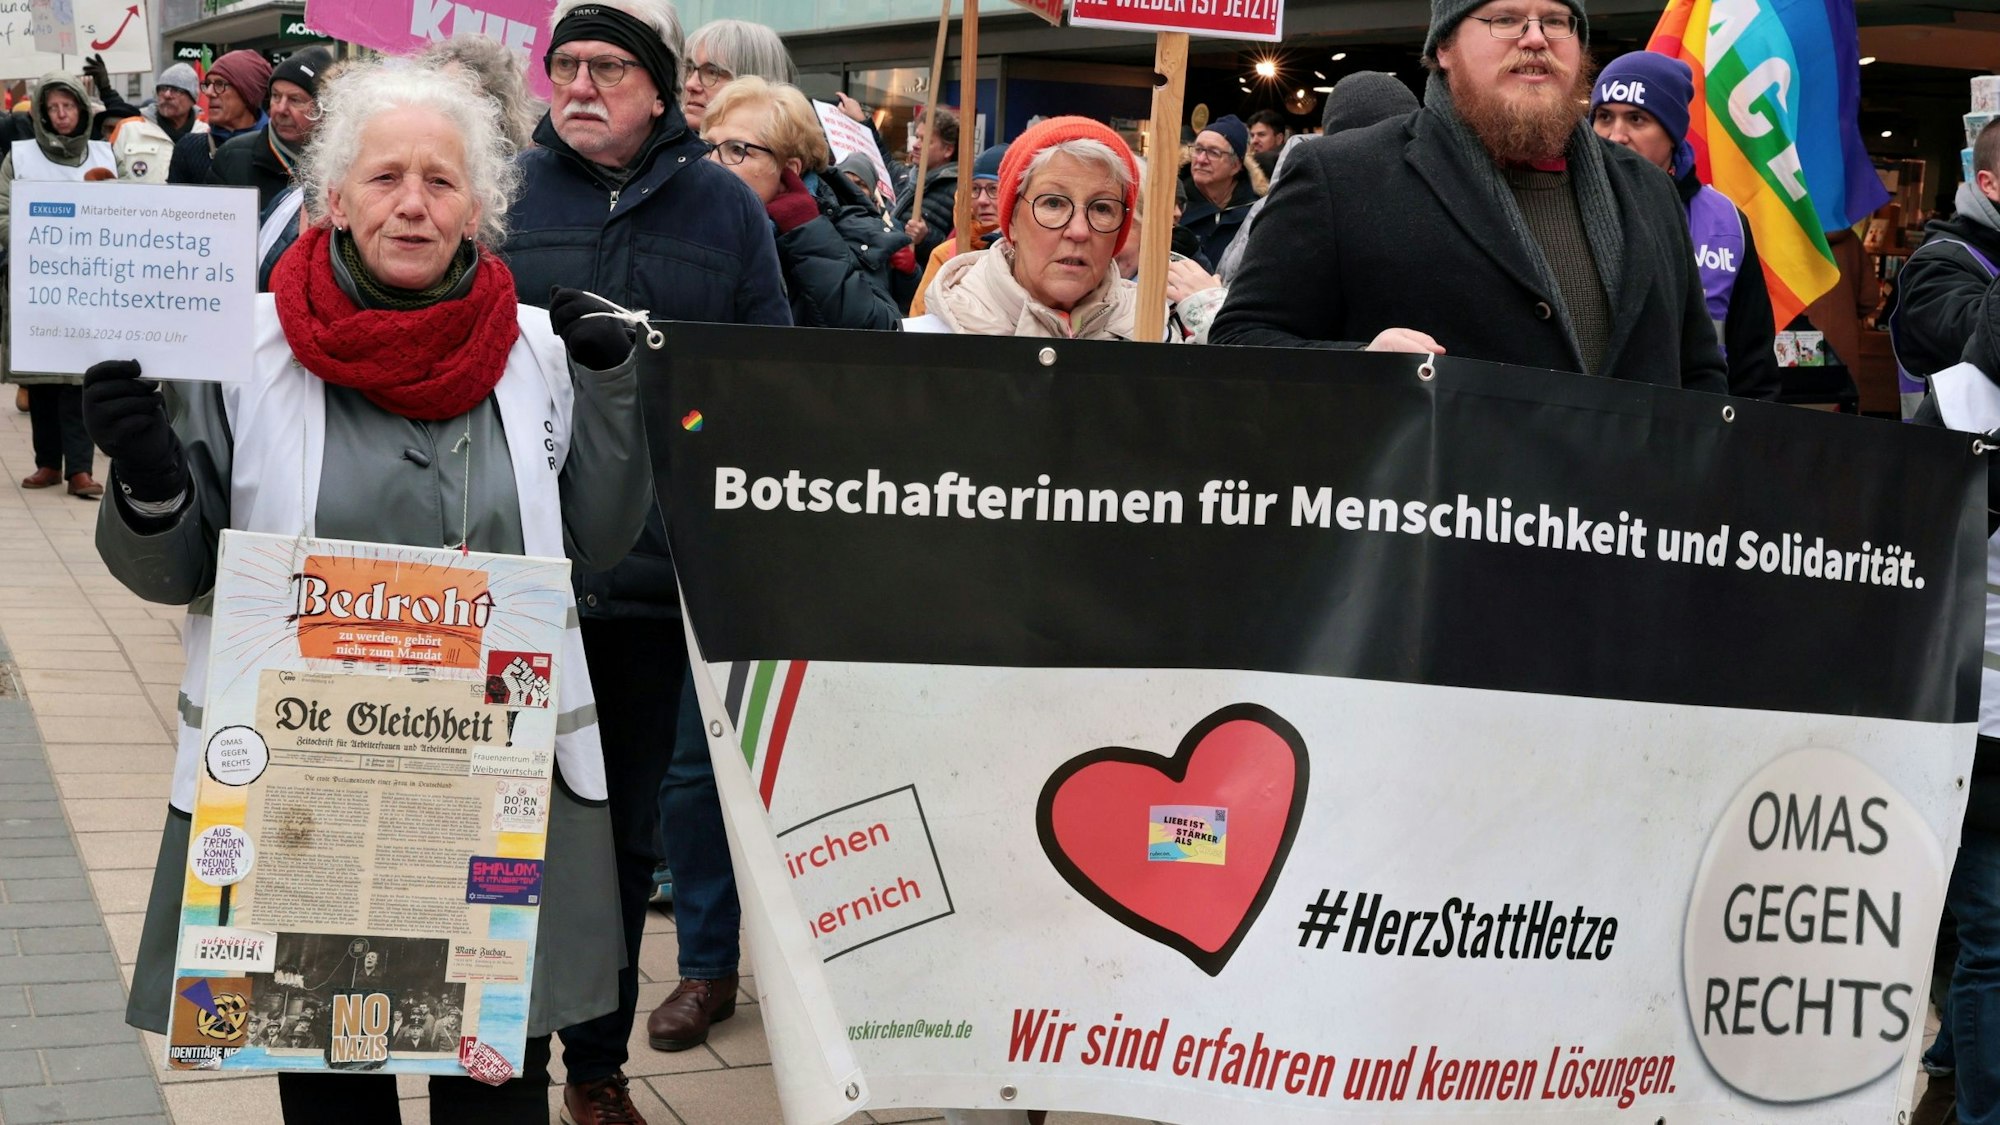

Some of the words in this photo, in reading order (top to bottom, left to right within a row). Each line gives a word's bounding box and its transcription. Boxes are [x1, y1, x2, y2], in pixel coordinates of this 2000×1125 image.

[1601, 80, 1646, 105] Volt
[33, 206, 71, 214] EXKLUSIV
[80, 205, 138, 217] Mitarbeiter
[140, 208, 158, 217] von
[161, 208, 236, 222] Abgeordneten
[28, 225, 63, 245] AfD
[69, 226, 92, 246] im
[100, 228, 212, 257] Bundestag
[1694, 244, 1736, 272] Volt
[29, 254, 135, 283] beschäftigt
[142, 260, 199, 281] mehr
[205, 262, 234, 282] als
[28, 286, 61, 305] 100
[67, 287, 221, 312] Rechtsextreme
[29, 326, 62, 337] Stand:
[63, 328, 122, 340] 12.03.2024
[125, 330, 161, 342] 05:00
[164, 332, 188, 343] Uhr
[715, 467, 1183, 524] Botschafterinnen
[1199, 479, 1278, 526] für
[1290, 485, 1647, 558] Menschlichkeit
[1657, 524, 1730, 567] und
[1735, 530, 1925, 590] Solidarität.
[339, 631, 353, 641] zu
[356, 631, 401, 645] werden,
[404, 634, 443, 647] gehört
[337, 645, 366, 656] nicht
[368, 649, 394, 658] zum
[397, 648, 443, 661] Mandat
[275, 697, 332, 732] Die
[347, 702, 493, 743] Gleichheit
[220, 738, 243, 746] OMAS
[296, 736, 333, 747] Zeitschrift
[336, 738, 348, 747] für
[403, 743, 417, 752] und
[421, 743, 467, 755] Arbeiterinnen
[221, 748, 248, 757] GEGEN
[473, 753, 530, 763] Frauenzentrum
[221, 759, 251, 768] RECHTS
[472, 765, 544, 776] Weiberwirtschaft
[1164, 816, 1188, 827] LIEBE
[1189, 820, 1205, 829] IST
[1748, 791, 1888, 855] OMAS
[212, 828, 232, 837] AUS
[1176, 828, 1218, 843] STÄRKER
[203, 837, 244, 849] FREMDEN
[1174, 836, 1192, 846] ALS
[196, 858, 236, 868] FREUNDE
[473, 862, 540, 878] SHALOM,
[201, 867, 238, 876] WERDEN
[1723, 883, 1901, 949] GEGEN
[1298, 888, 1618, 961] #HerzStattHetze
[200, 945, 262, 960] FRAUEN
[332, 993, 390, 1037] NO
[1704, 976, 1913, 1042] RECHTS
[171, 1045, 222, 1059] IDENTITÄRE
[331, 1035, 388, 1062] NAZIS
[1008, 1008, 1077, 1063] Wir
[1081, 1013, 1170, 1071] sind
[1172, 1027, 1336, 1098] erfahren
[1343, 1045, 1418, 1101] und
[1416, 1046, 1538, 1101] kennen
[1541, 1046, 1676, 1109] Lösungen.
